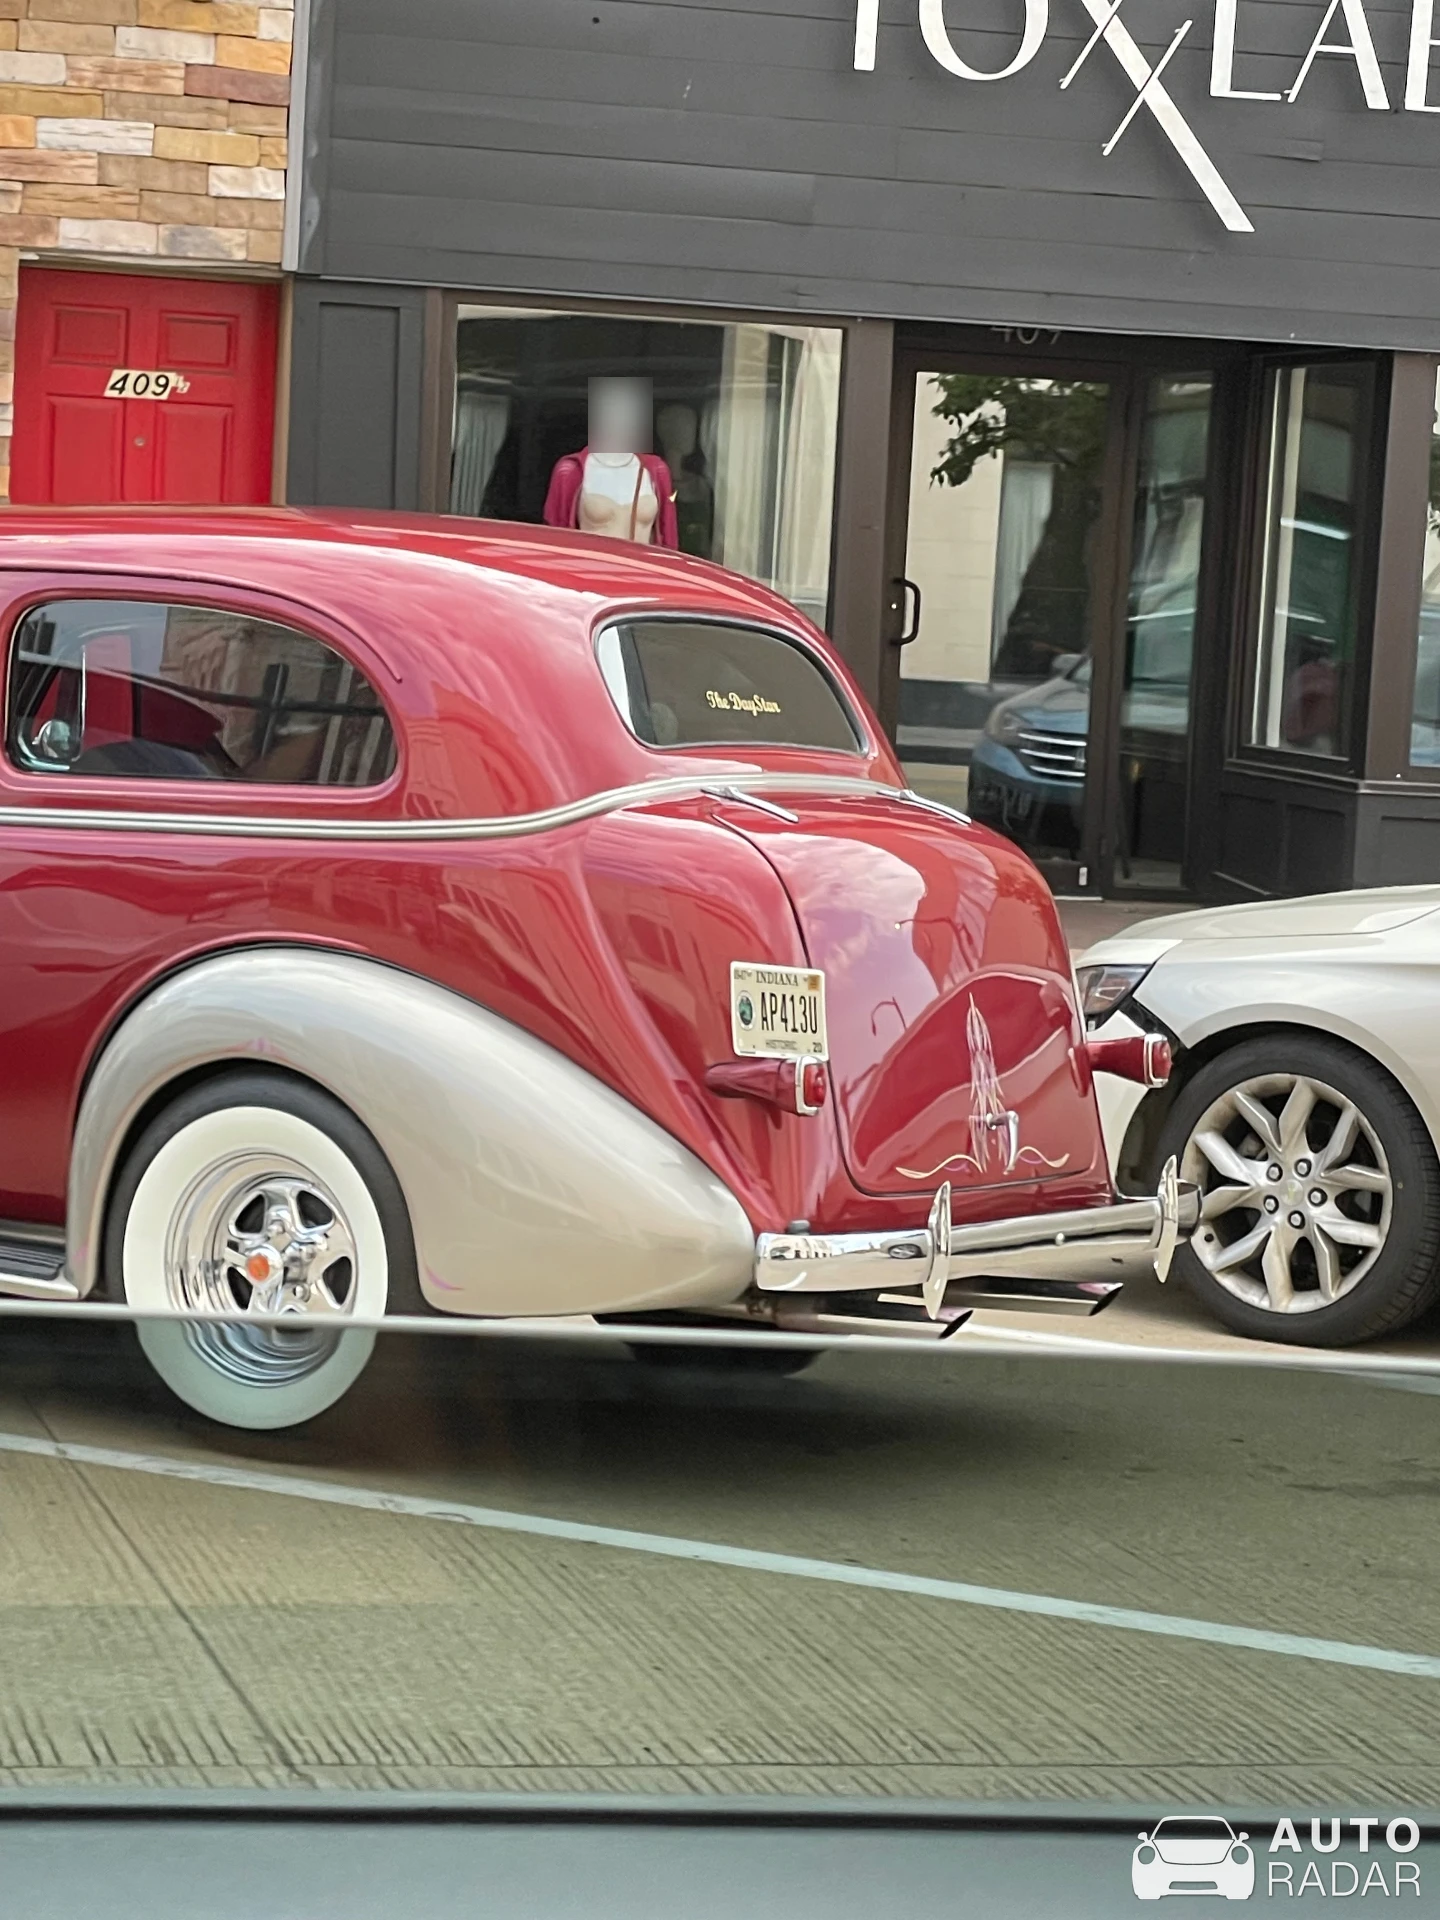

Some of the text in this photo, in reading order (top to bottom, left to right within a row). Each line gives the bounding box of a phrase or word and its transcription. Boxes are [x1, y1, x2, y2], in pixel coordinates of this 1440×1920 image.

[109, 373, 170, 397] 409
[706, 690, 731, 709] The
[756, 970, 799, 987] INDIANA
[761, 991, 818, 1034] AP413U
